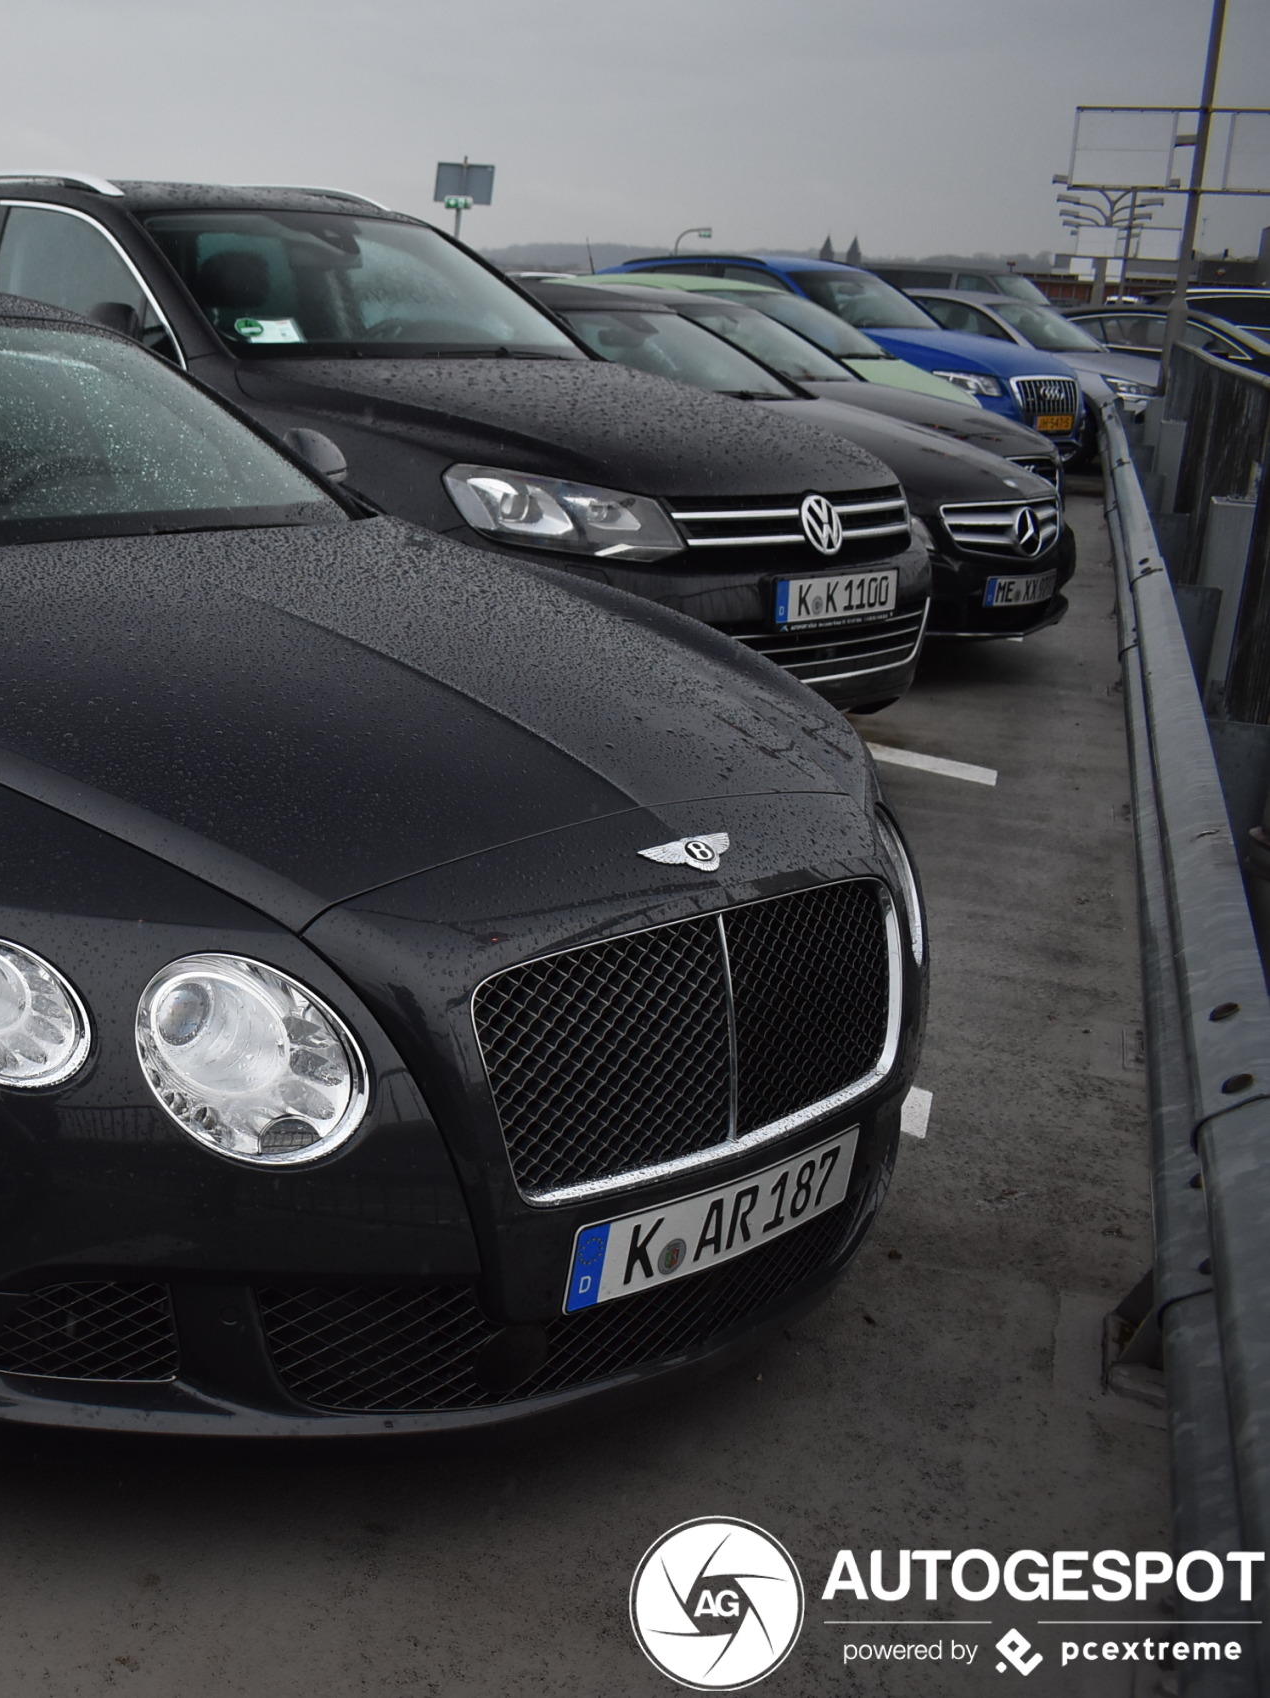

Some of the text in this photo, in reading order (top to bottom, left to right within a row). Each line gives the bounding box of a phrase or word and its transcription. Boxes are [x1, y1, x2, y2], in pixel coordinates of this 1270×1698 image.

[798, 583, 812, 616] K
[995, 581, 1016, 603] ME
[578, 1275, 592, 1294] D
[623, 1217, 665, 1285] K
